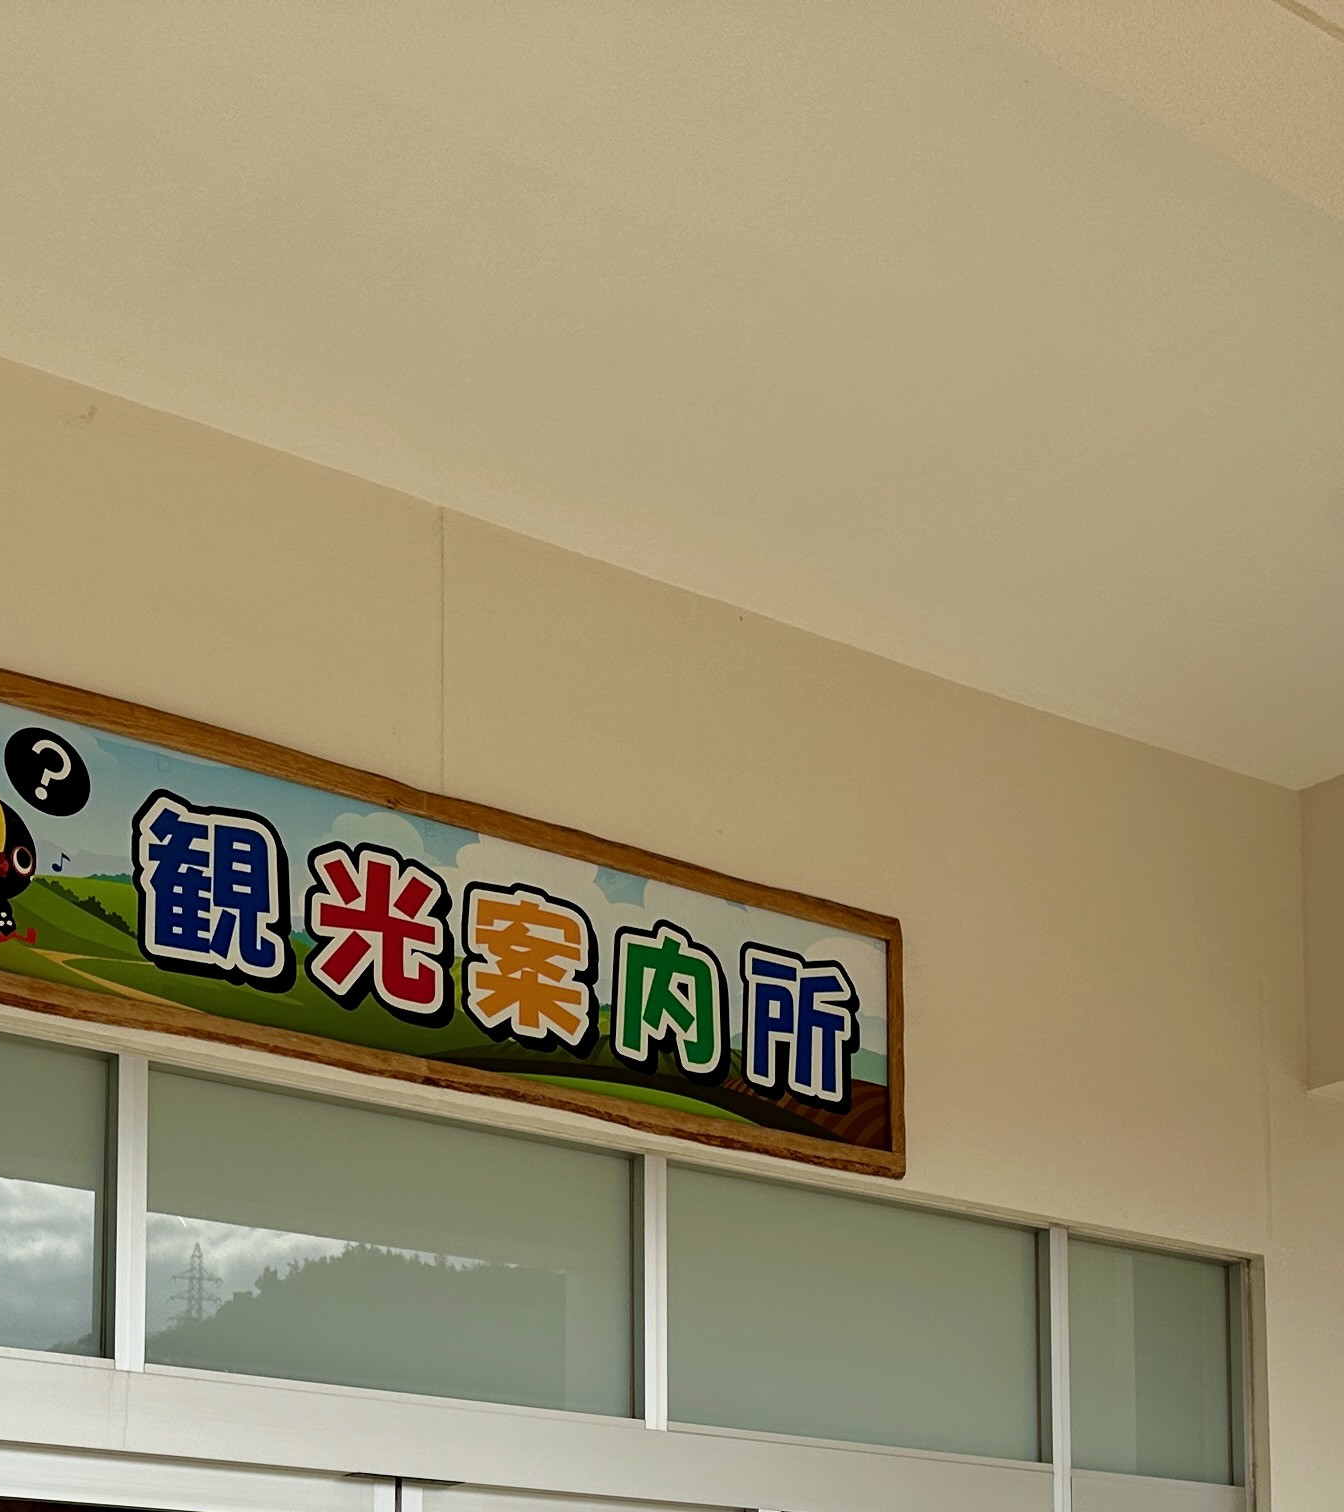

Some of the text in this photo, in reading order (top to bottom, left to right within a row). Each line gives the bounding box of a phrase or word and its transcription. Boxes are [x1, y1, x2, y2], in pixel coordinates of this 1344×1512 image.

[142, 797, 856, 1103] 観光案内所
